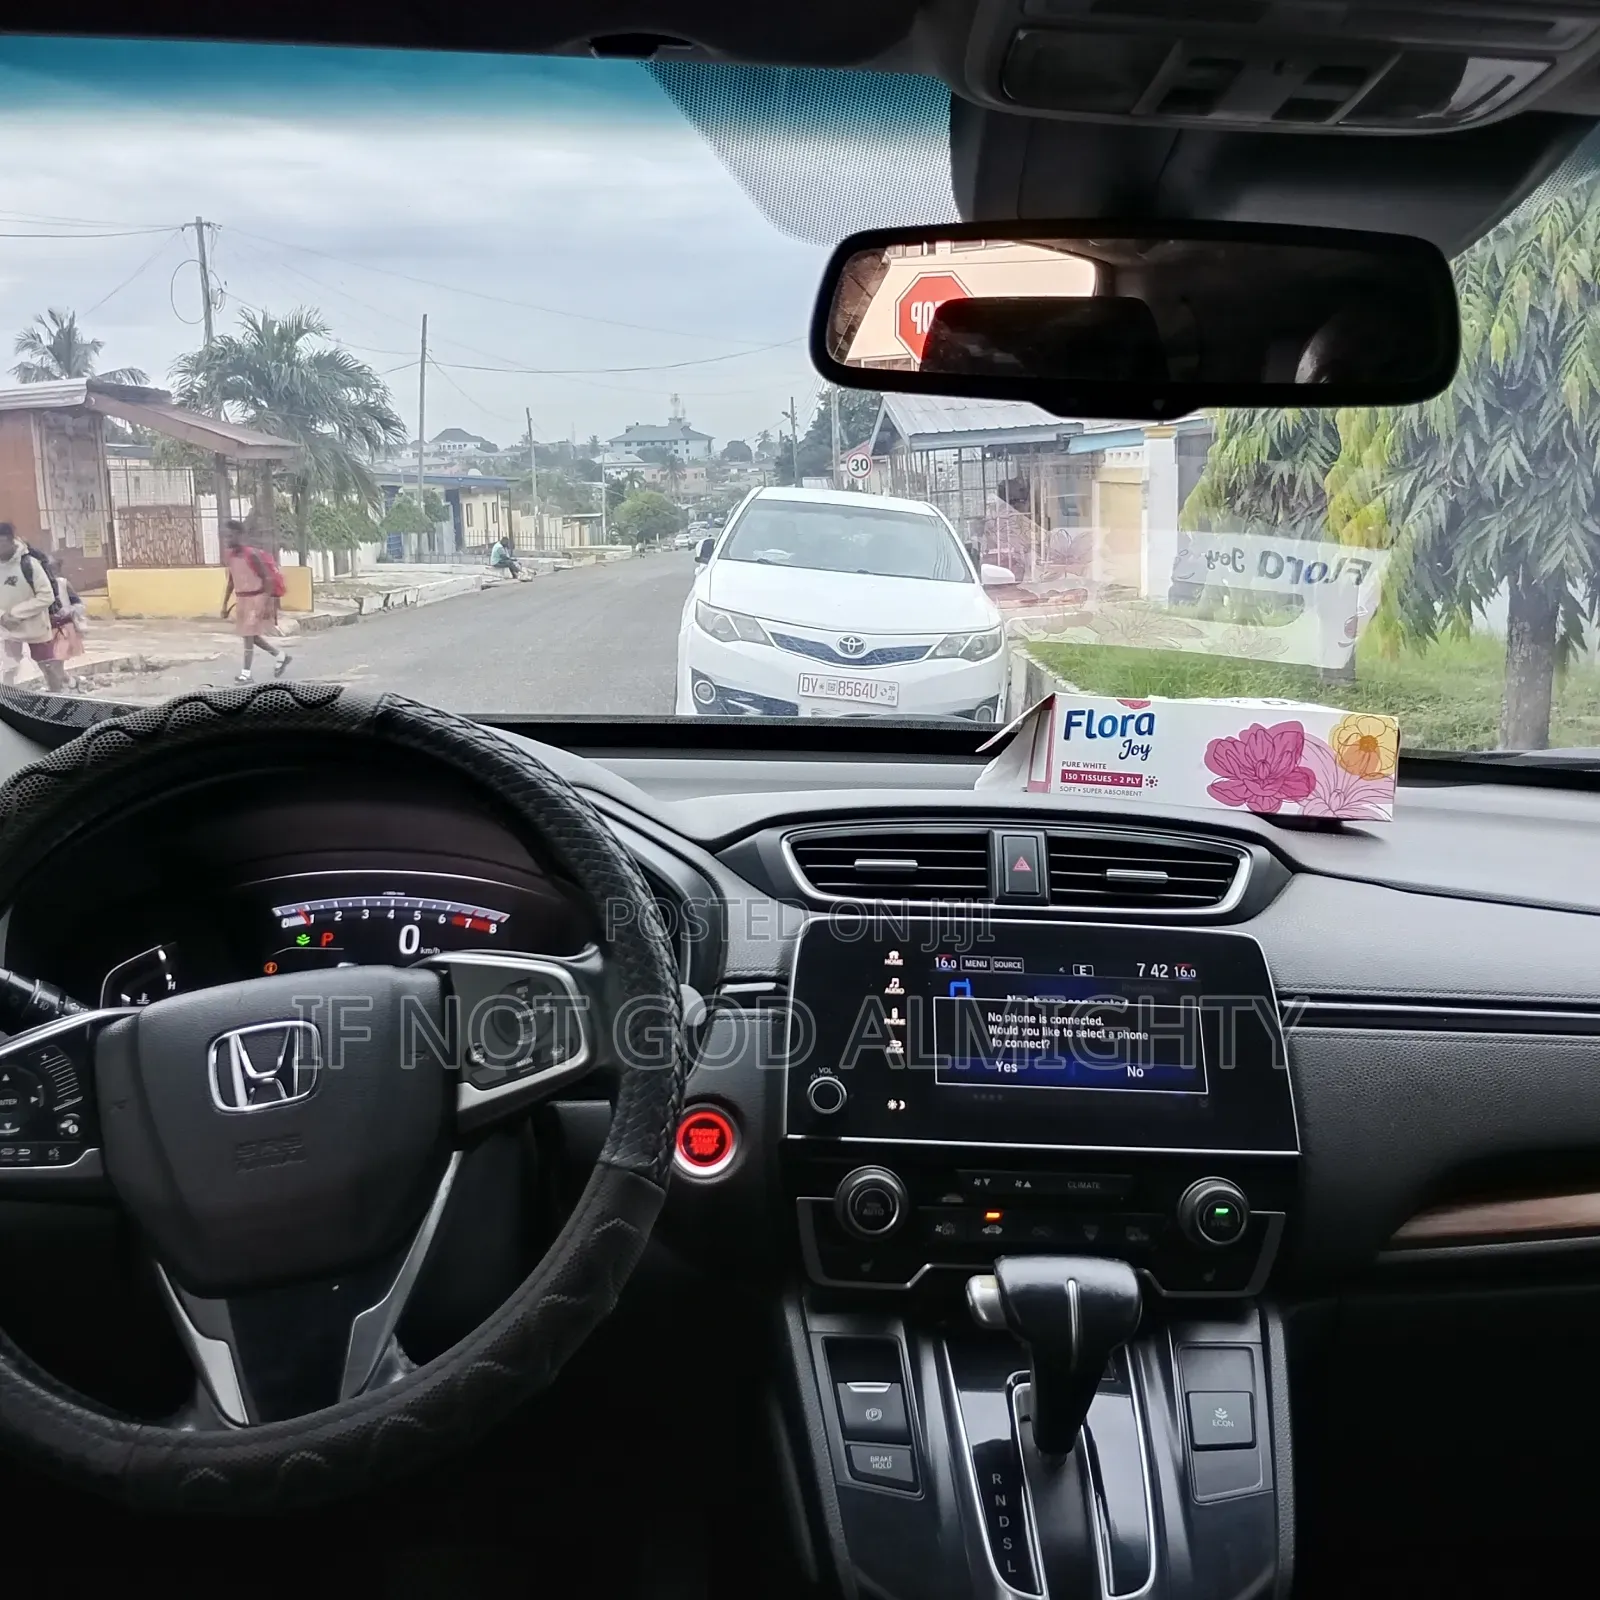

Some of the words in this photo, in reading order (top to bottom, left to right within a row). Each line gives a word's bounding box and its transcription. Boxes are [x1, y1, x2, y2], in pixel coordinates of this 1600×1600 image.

[851, 458, 869, 472] 30
[1063, 709, 1155, 741] Flora
[1118, 739, 1152, 761] Joy
[1061, 760, 1081, 768] PURE
[1082, 761, 1107, 770] WHITE
[1064, 772, 1078, 780] 150
[1079, 773, 1112, 782] TISSUES
[1103, 789, 1143, 797] ABSORBENT
[281, 917, 289, 928] 0
[334, 911, 343, 921] 2
[362, 909, 370, 920] 3
[387, 909, 395, 919] 4
[413, 910, 422, 921] 5
[438, 913, 446, 924] 6
[465, 918, 473, 928] 7
[489, 923, 498, 934] 8
[320, 932, 334, 947] P
[399, 924, 421, 955] 0
[934, 956, 957, 969] 16.0
[965, 960, 988, 968] MENU
[994, 961, 1022, 969] SOURCE
[1174, 965, 1197, 978] 16.0
[988, 1012, 1002, 1022] No
[1004, 1012, 1036, 1024] phone
[1038, 1013, 1047, 1024] is
[1049, 1015, 1104, 1026] connected.
[988, 1025, 1019, 1035] Would
[1021, 1027, 1040, 1037] you
[1042, 1026, 1060, 1037] like
[1062, 1027, 1073, 1037] to
[1075, 1028, 1106, 1038] select
[1108, 1030, 1114, 1039] a
[1117, 1029, 1149, 1041] phone
[992, 1038, 1002, 1047] to
[1004, 1038, 1050, 1049] connect?
[995, 1060, 1018, 1073] Yes
[1127, 1065, 1144, 1077] No
[1067, 1181, 1101, 1189] CLIMATE
[1212, 1419, 1235, 1427] ECON
[870, 1455, 892, 1463] BRAKE
[992, 1473, 1002, 1485] R
[995, 1494, 1007, 1506] N
[999, 1515, 1010, 1528] D
[1003, 1537, 1012, 1550] S
[1006, 1560, 1017, 1573] L
